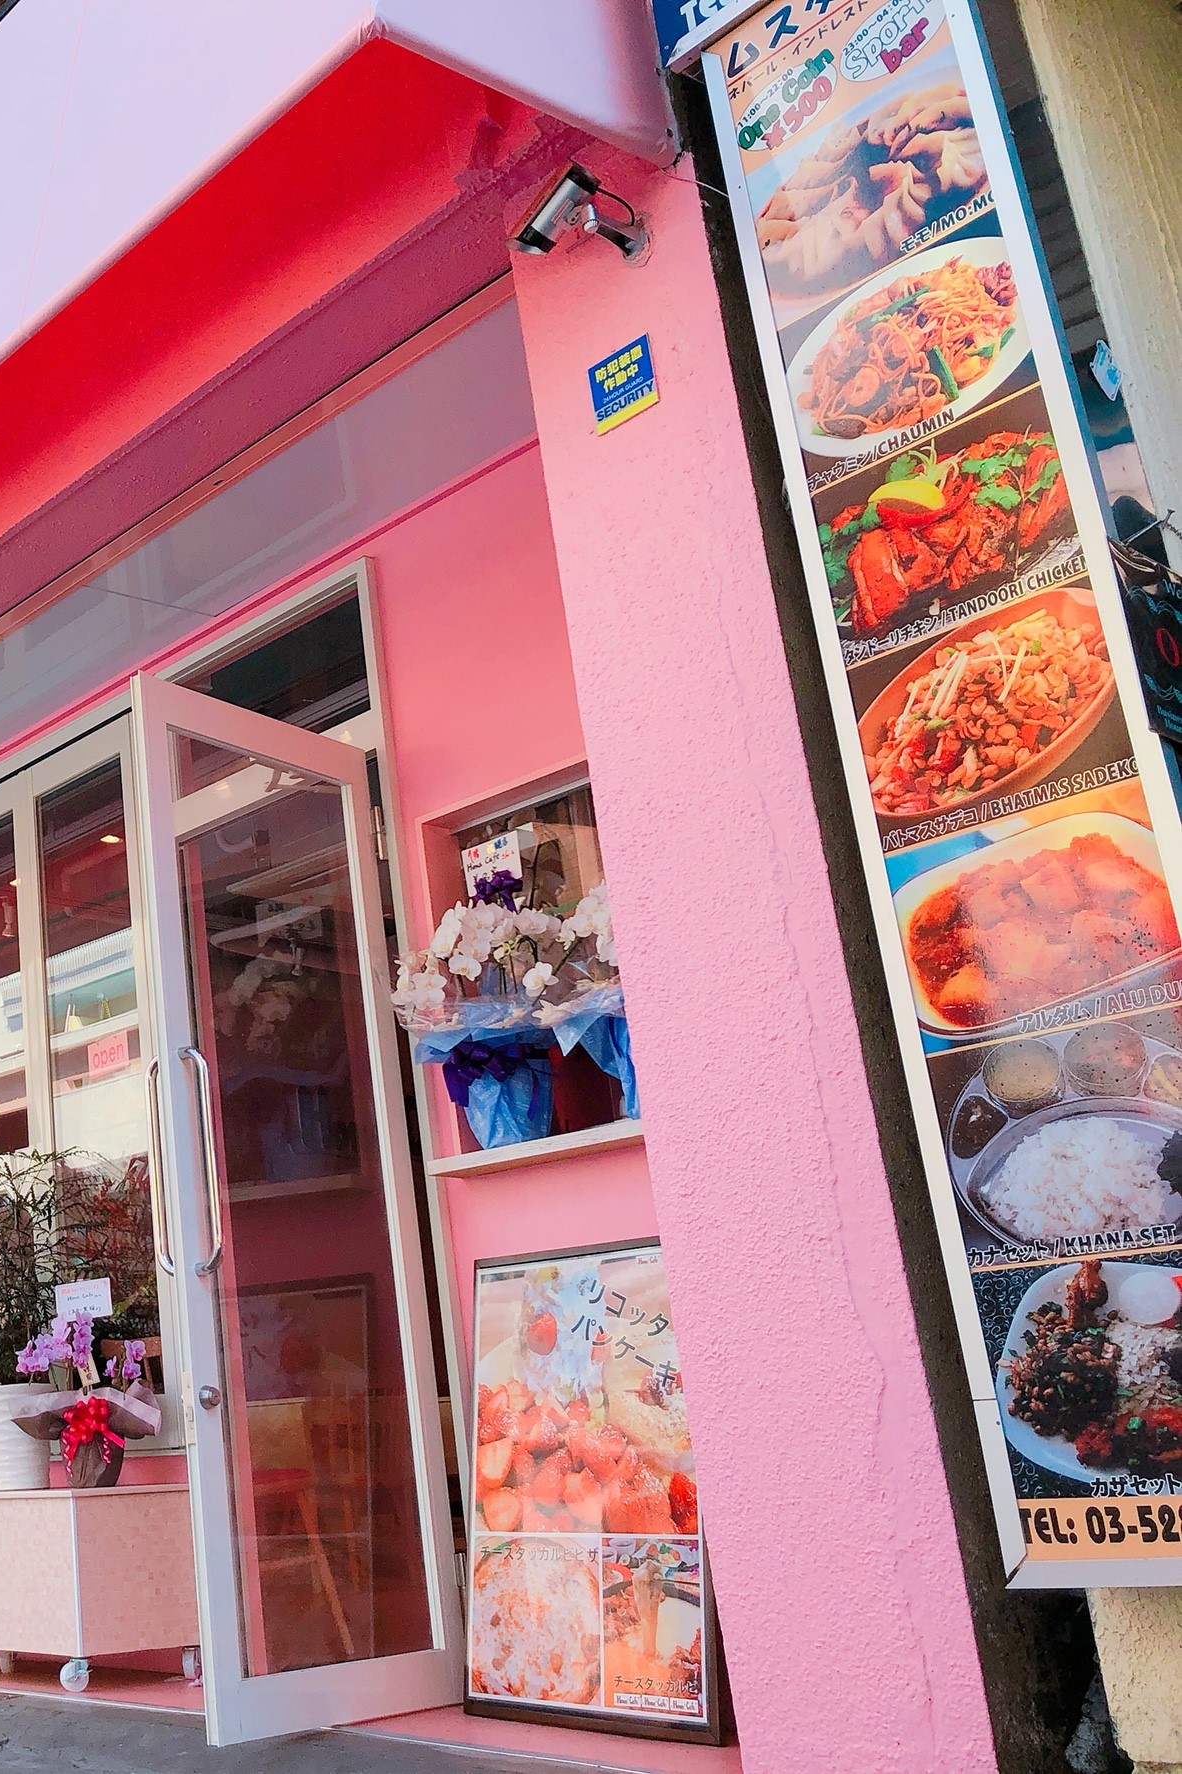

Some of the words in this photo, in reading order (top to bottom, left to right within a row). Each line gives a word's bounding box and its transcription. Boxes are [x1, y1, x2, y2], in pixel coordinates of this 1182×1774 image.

[726, 0, 832, 79] ムス
[845, 0, 931, 79] Sport
[880, 17, 929, 74] bar
[738, 103, 781, 150] One
[782, 48, 835, 104] Coin
[596, 380, 654, 422] SECURITY
[948, 582, 1024, 622] TANDOORI
[990, 780, 1069, 817] BHATMAS
[1107, 988, 1146, 1015] ALU
[1150, 979, 1182, 1005] DU
[92, 1043, 124, 1069] open
[1067, 1229, 1136, 1256] KHANA
[1140, 1223, 1176, 1247] SET
[588, 1279, 670, 1337] リコッタ
[571, 1315, 678, 1388] パンケーキ
[1019, 1507, 1078, 1545] TEL:
[1085, 1504, 1182, 1545] 03-52
